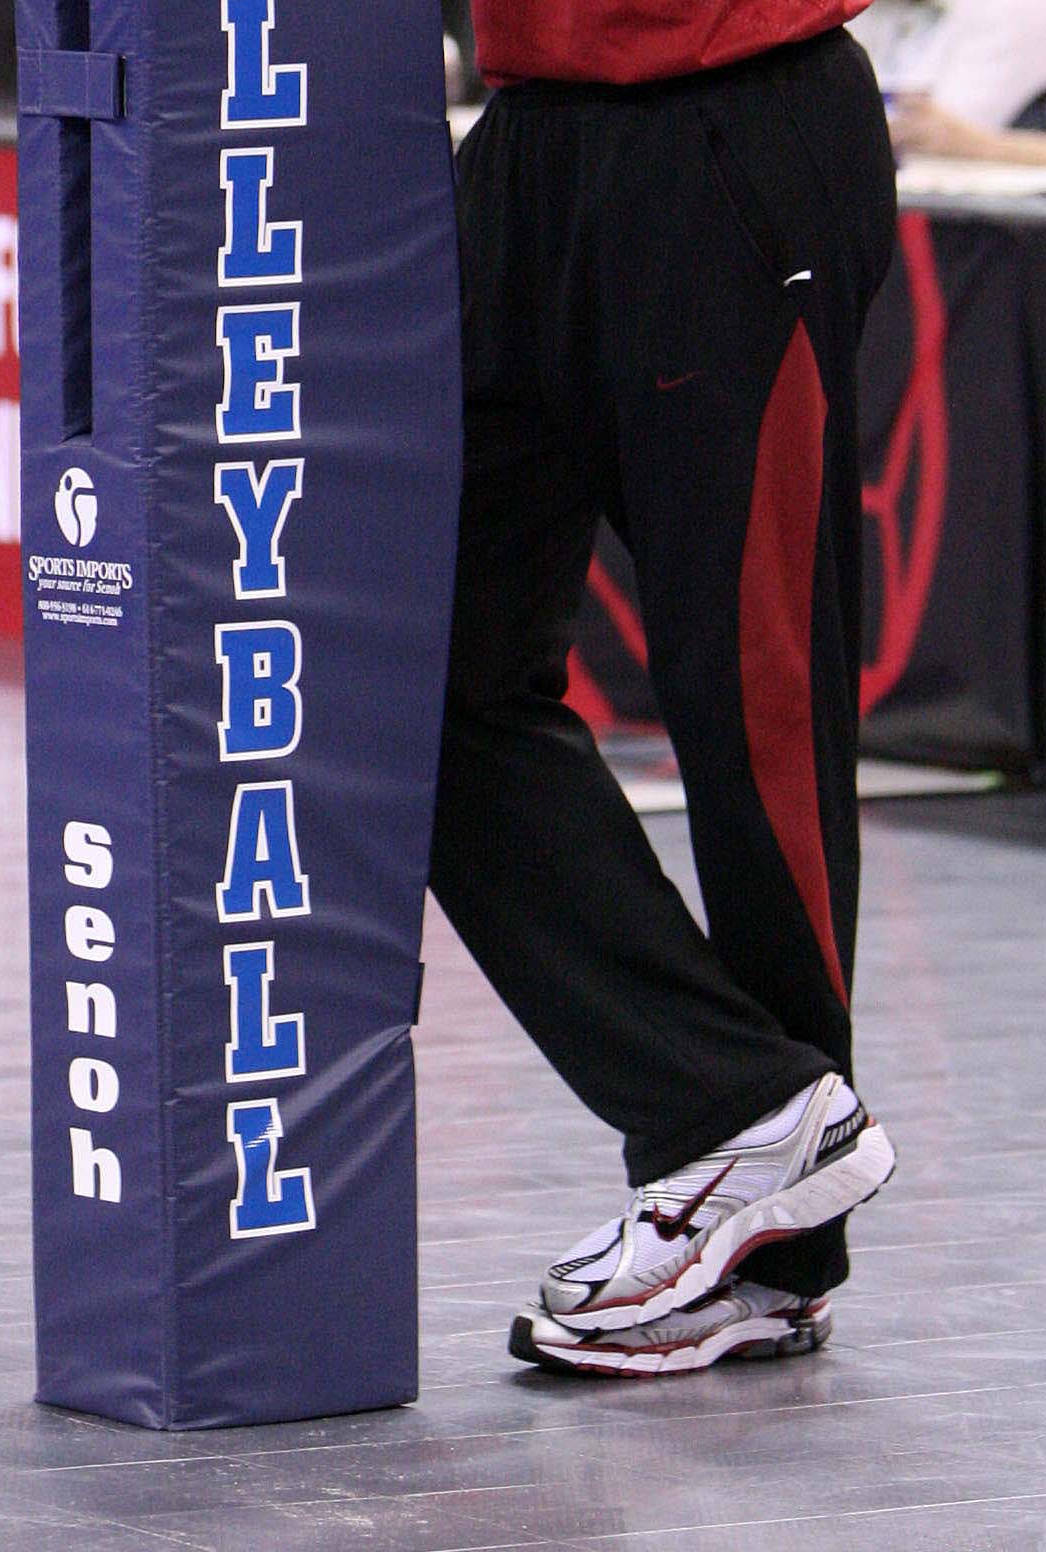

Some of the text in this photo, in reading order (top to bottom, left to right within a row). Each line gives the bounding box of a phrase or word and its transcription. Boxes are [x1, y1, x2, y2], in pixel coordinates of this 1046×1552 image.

[28, 555, 133, 589] SPORTS IMPORTS
[37, 578, 121, 595] your source for Senoh
